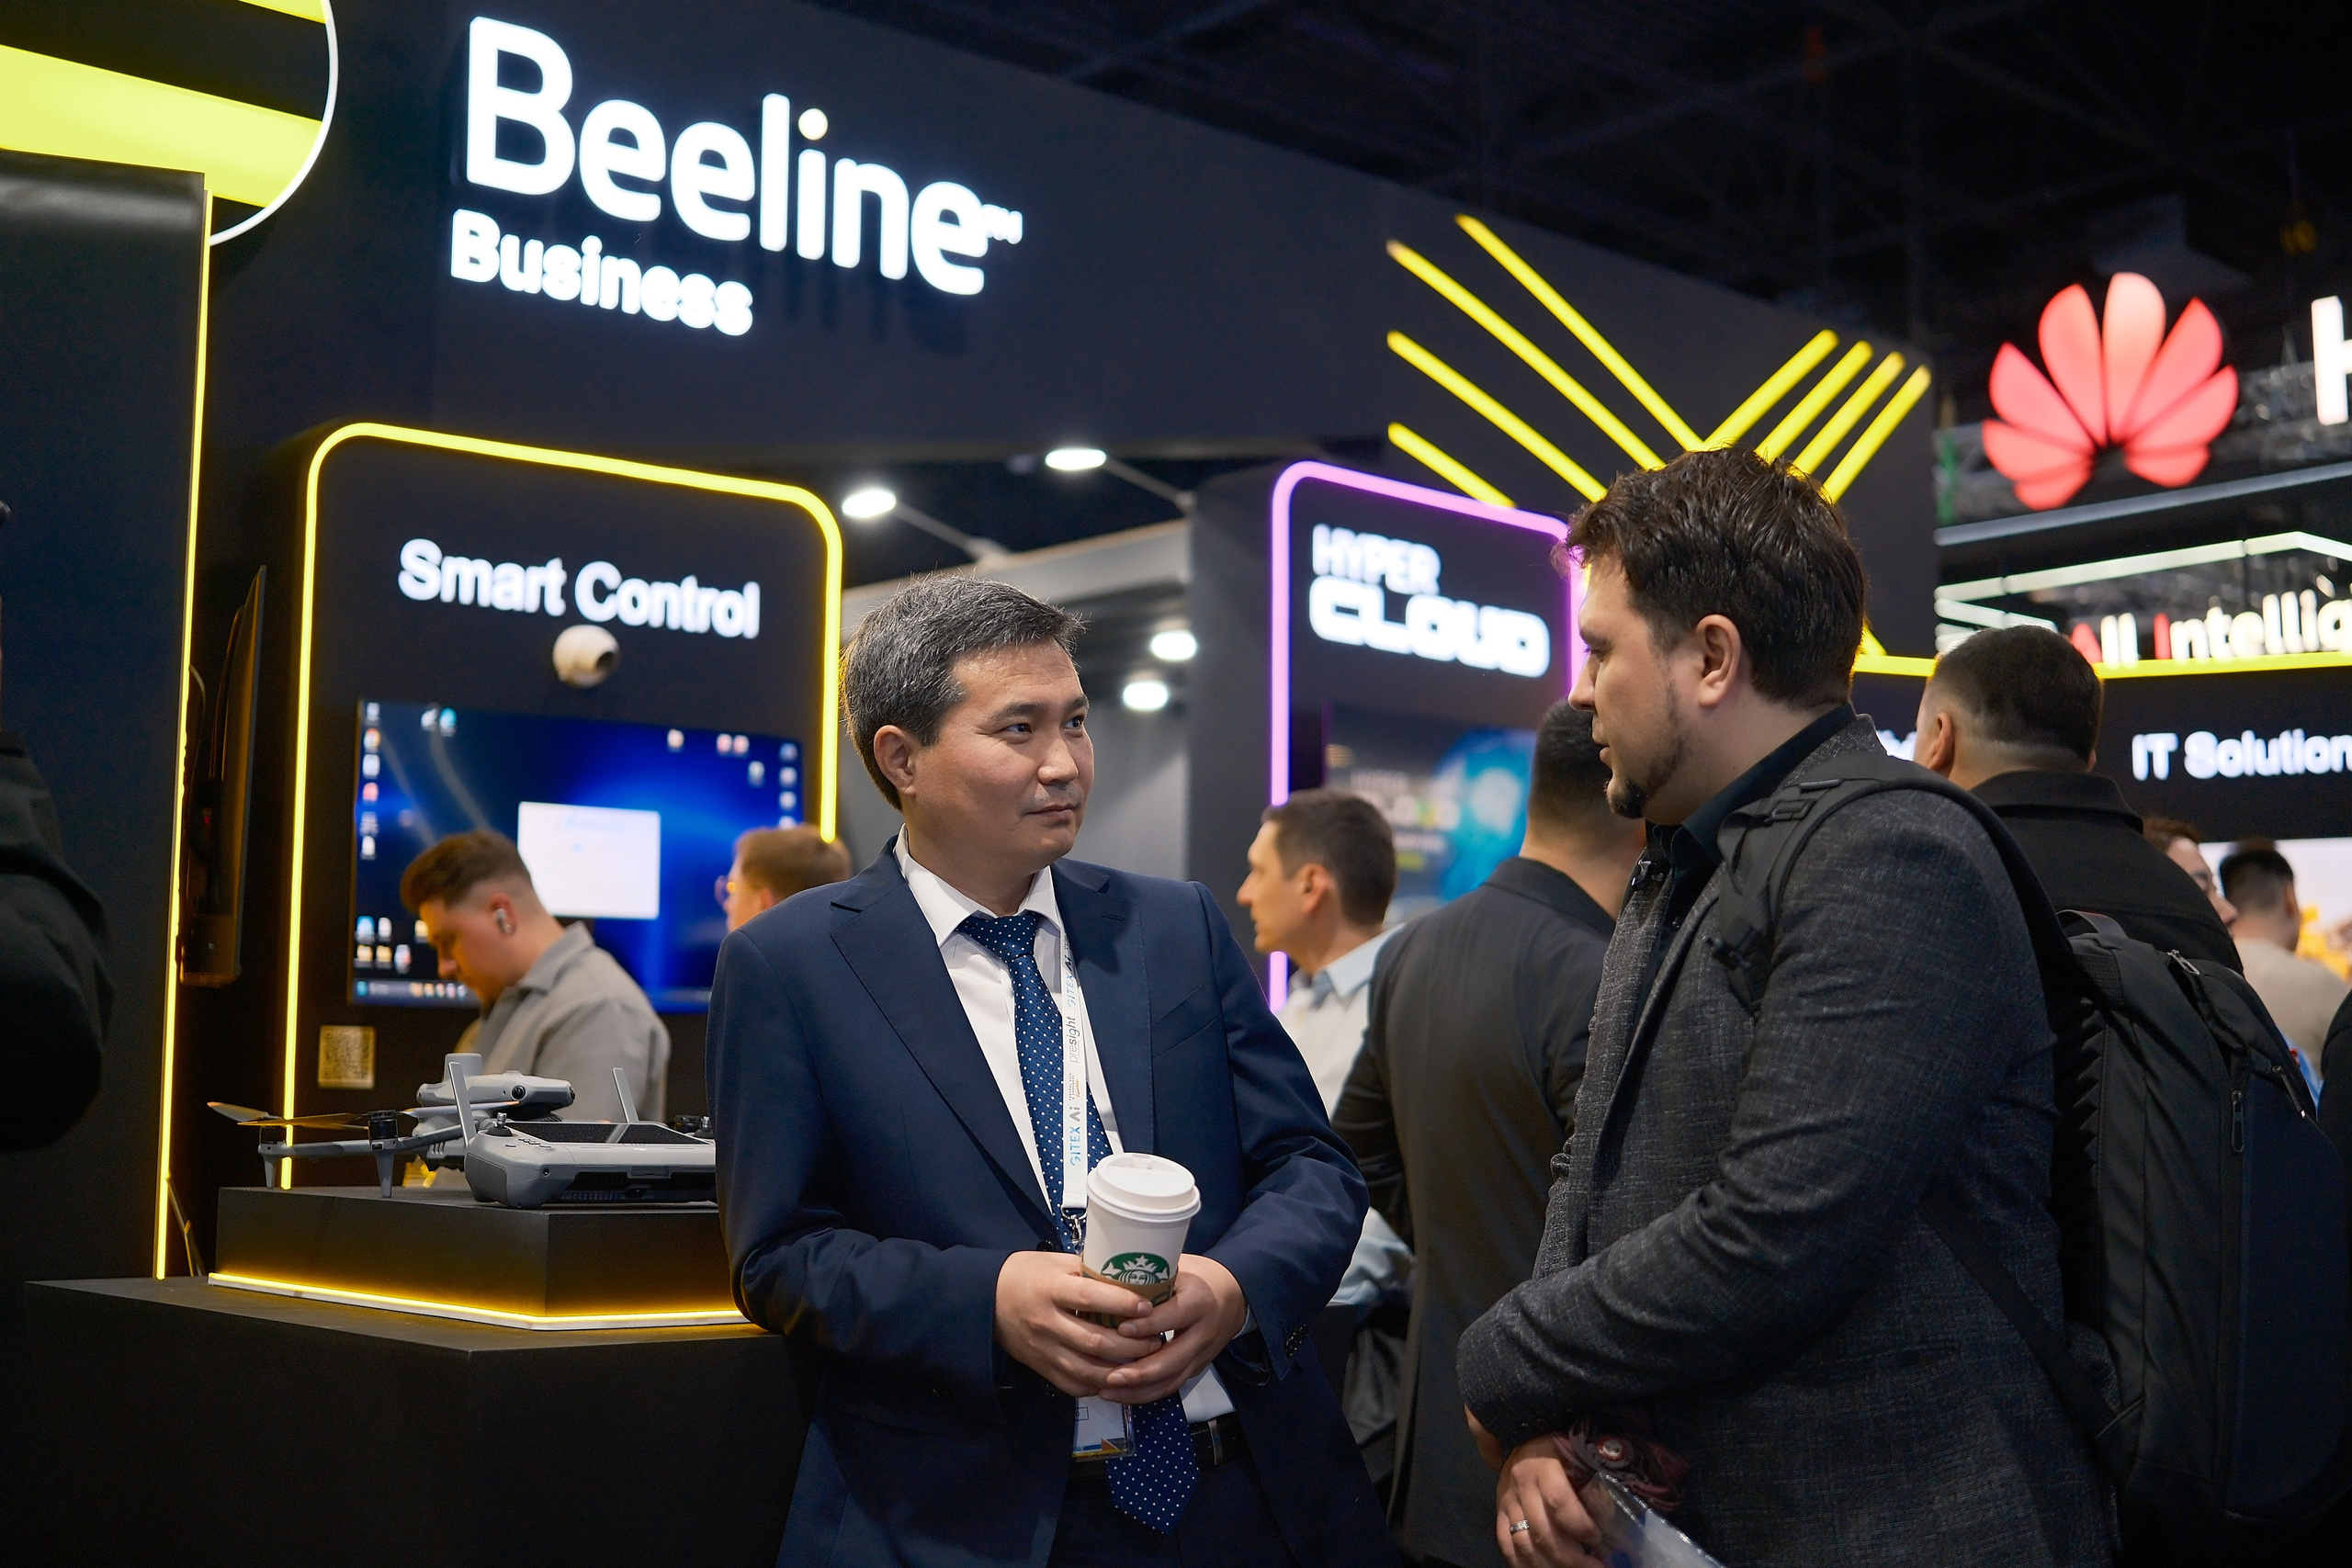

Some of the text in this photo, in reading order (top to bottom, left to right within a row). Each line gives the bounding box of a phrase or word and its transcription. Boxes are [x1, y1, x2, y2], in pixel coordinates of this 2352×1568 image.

[467, 16, 988, 295] Beeline
[451, 209, 753, 335] Business
[398, 538, 761, 639] Smart Control
[1312, 524, 1442, 595] HYPER
[1309, 575, 1550, 678] CLOUD
[2132, 732, 2178, 781] IT
[1066, 973, 1076, 1008] GITEX
[1066, 1015, 1080, 1064] presight
[1069, 1126, 1081, 1167] GITEX
